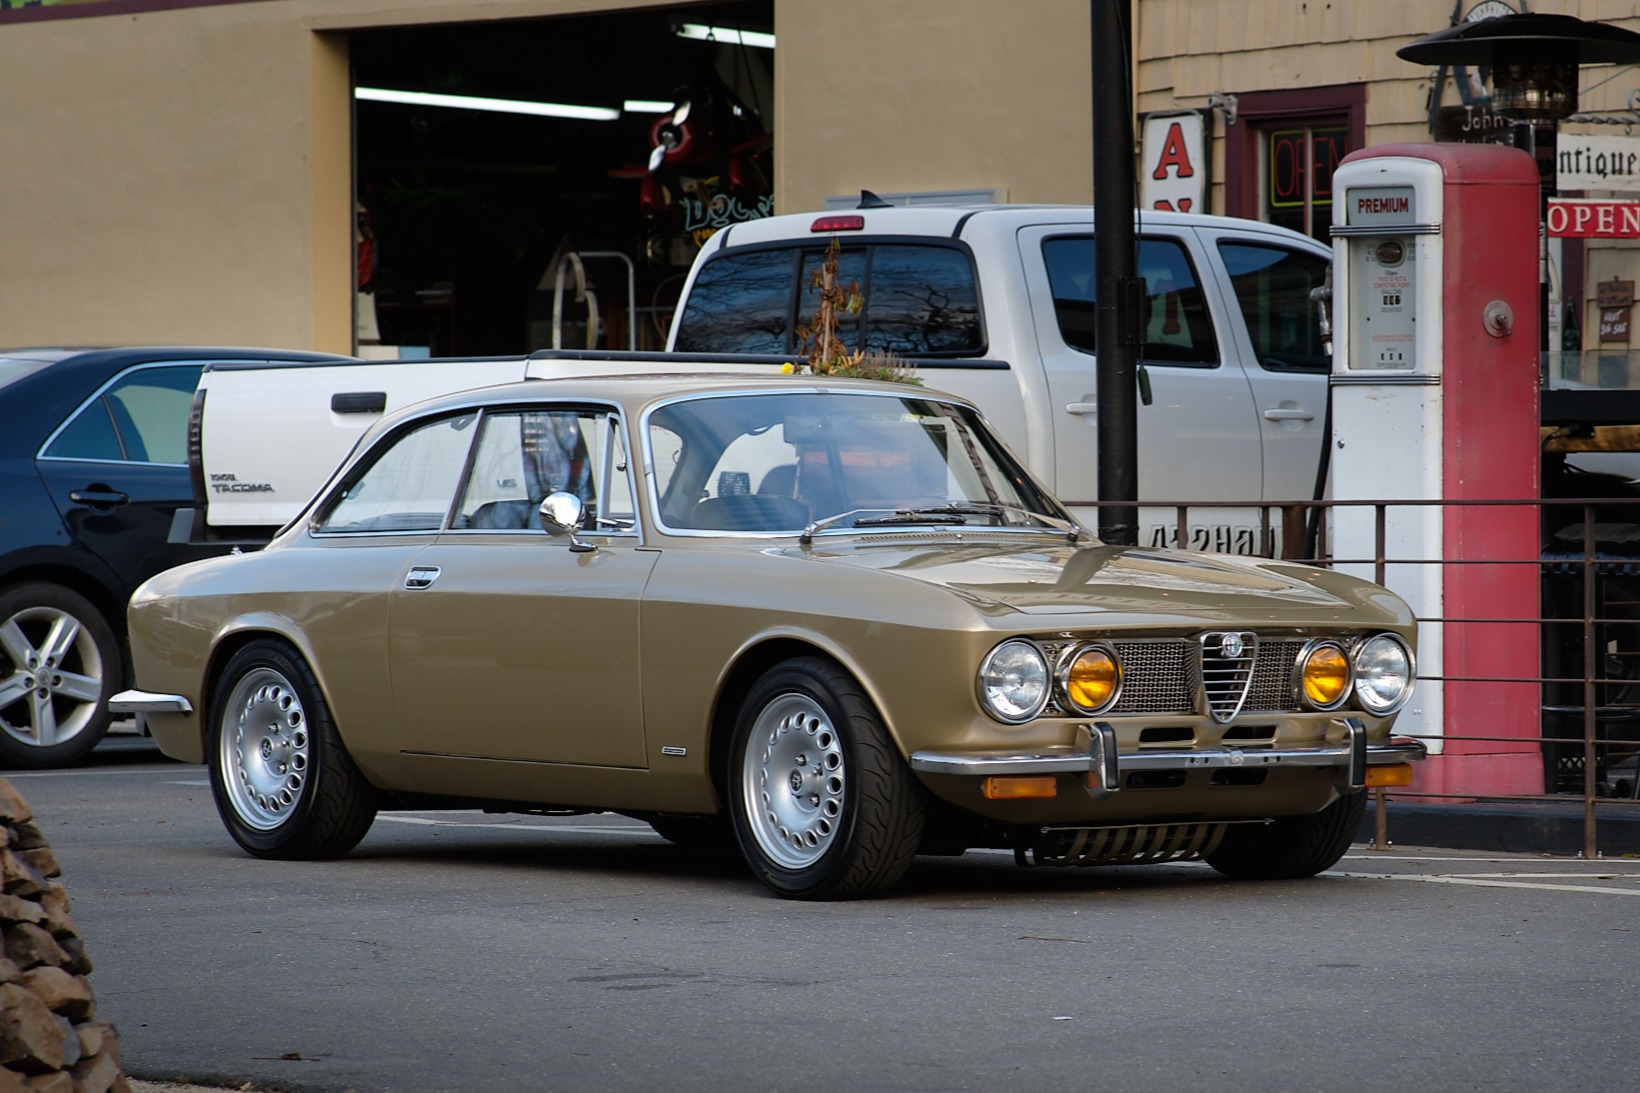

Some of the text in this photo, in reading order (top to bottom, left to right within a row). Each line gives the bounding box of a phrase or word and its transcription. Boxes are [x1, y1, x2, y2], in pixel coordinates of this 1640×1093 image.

[1558, 146, 1640, 179] ntique
[1358, 197, 1409, 214] PREMIUM
[1547, 205, 1640, 234] OPEN
[211, 484, 275, 493] TACOMA
